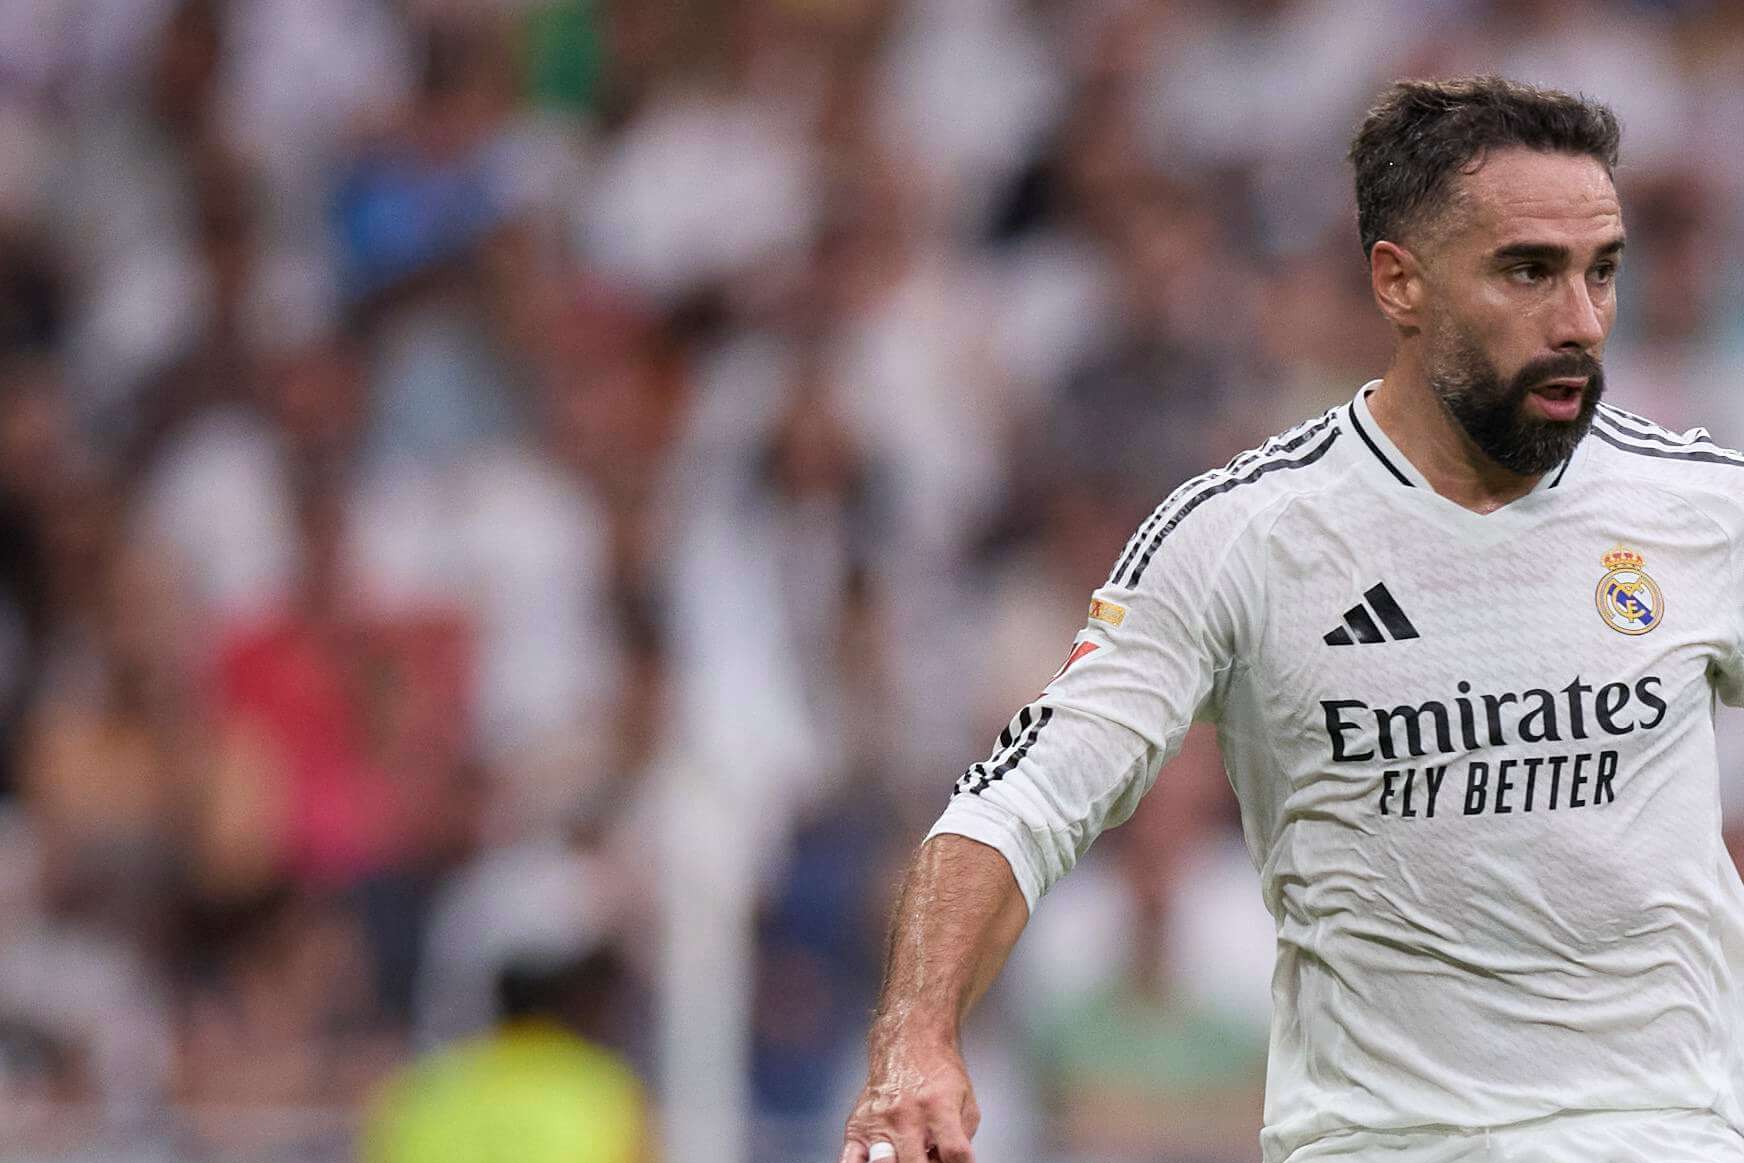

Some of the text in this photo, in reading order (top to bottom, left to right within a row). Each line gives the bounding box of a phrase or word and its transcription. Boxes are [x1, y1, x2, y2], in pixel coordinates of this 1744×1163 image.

[1319, 674, 1668, 762] Emirates
[1379, 750, 1619, 818] FLY BETTER
